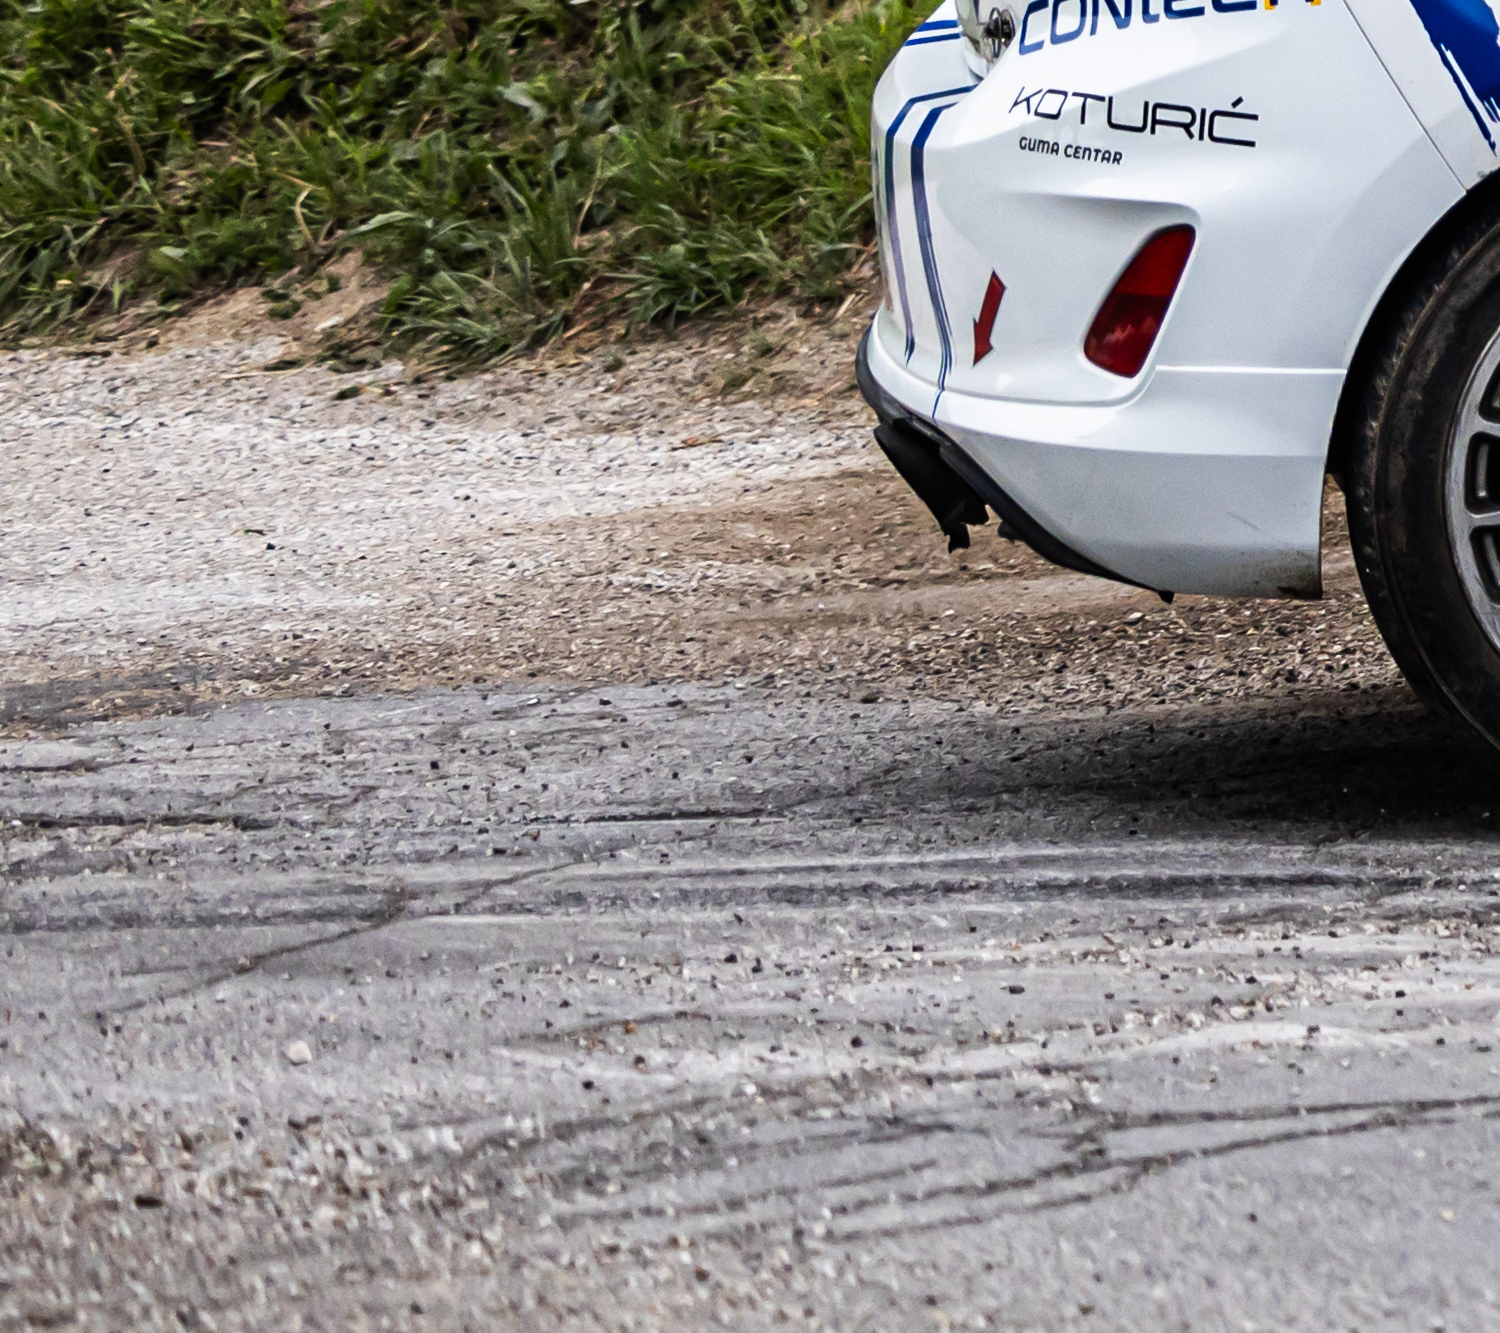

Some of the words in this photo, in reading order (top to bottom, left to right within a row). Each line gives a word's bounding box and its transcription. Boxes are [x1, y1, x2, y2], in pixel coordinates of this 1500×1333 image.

[1009, 86, 1259, 148] KOTURIĆ
[1019, 136, 1060, 156] GUMA
[1064, 144, 1123, 165] CENTAR
